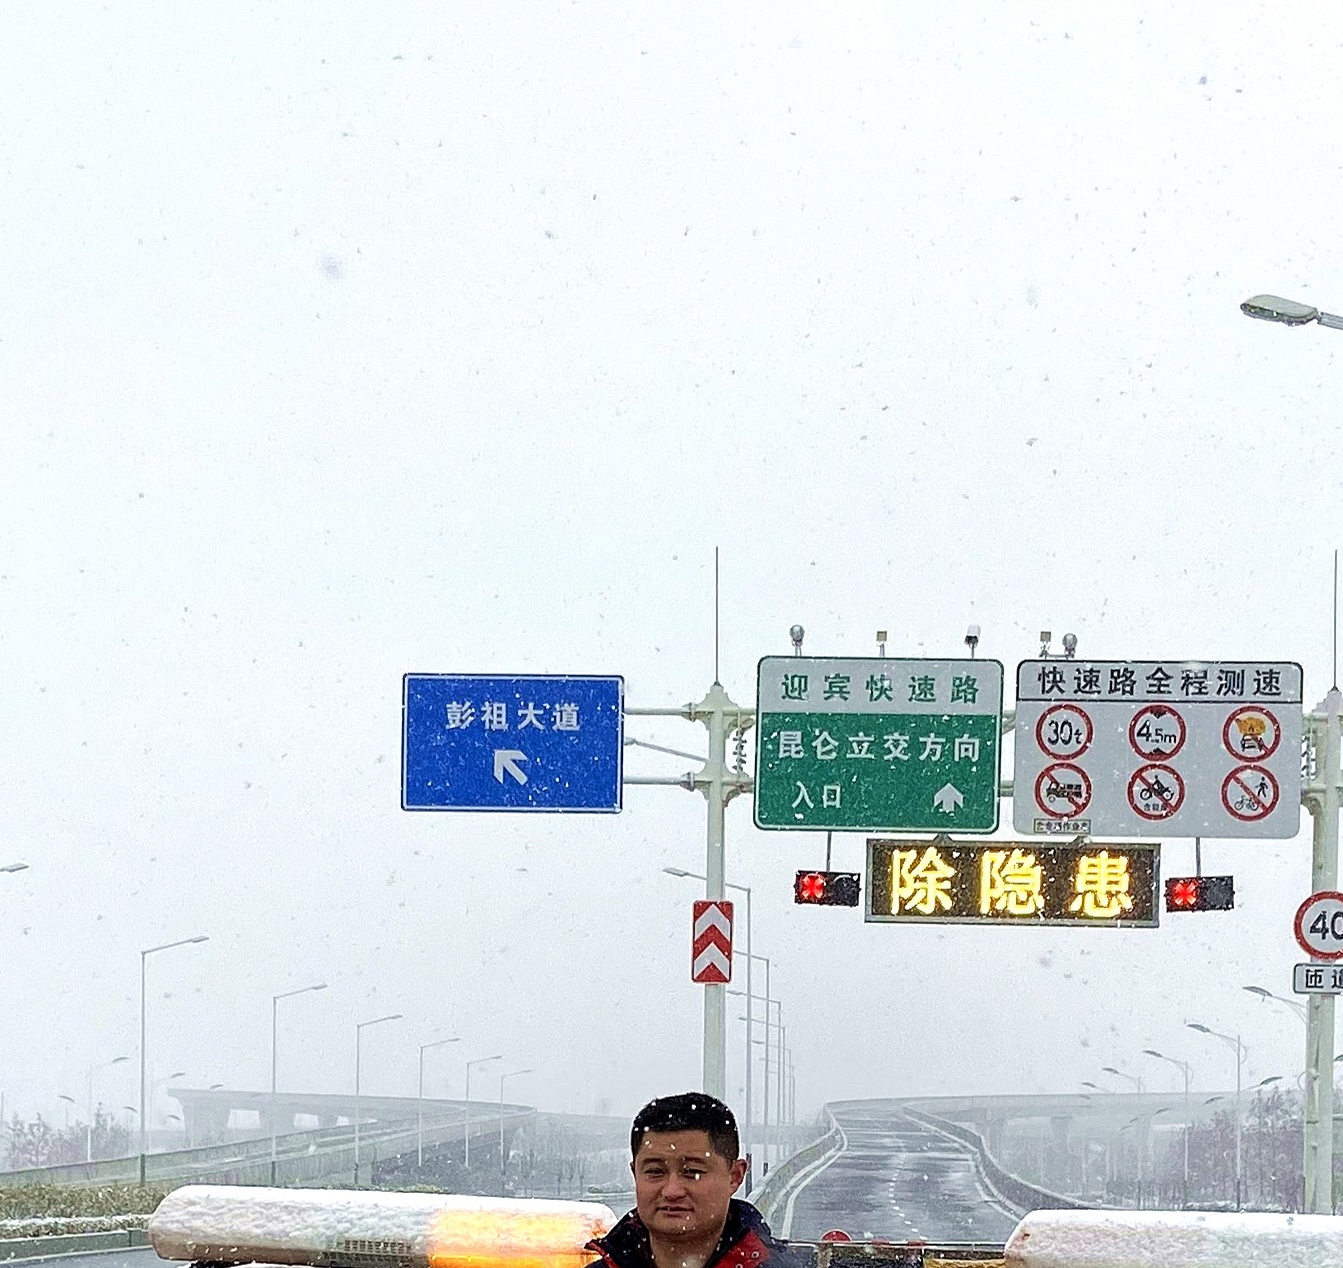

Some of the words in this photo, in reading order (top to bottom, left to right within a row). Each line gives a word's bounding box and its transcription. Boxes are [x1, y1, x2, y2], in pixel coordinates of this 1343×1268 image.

[781, 673, 979, 704] 迎宾快速路
[1037, 666, 1282, 697] 快速路全程测速
[446, 701, 580, 731] 彭祖大道
[778, 731, 980, 762] 昆仑立交方向
[1047, 720, 1083, 745] 30t
[1136, 719, 1177, 744] 4.5m
[791, 781, 842, 809] 入口
[888, 846, 1134, 919] 除隐患
